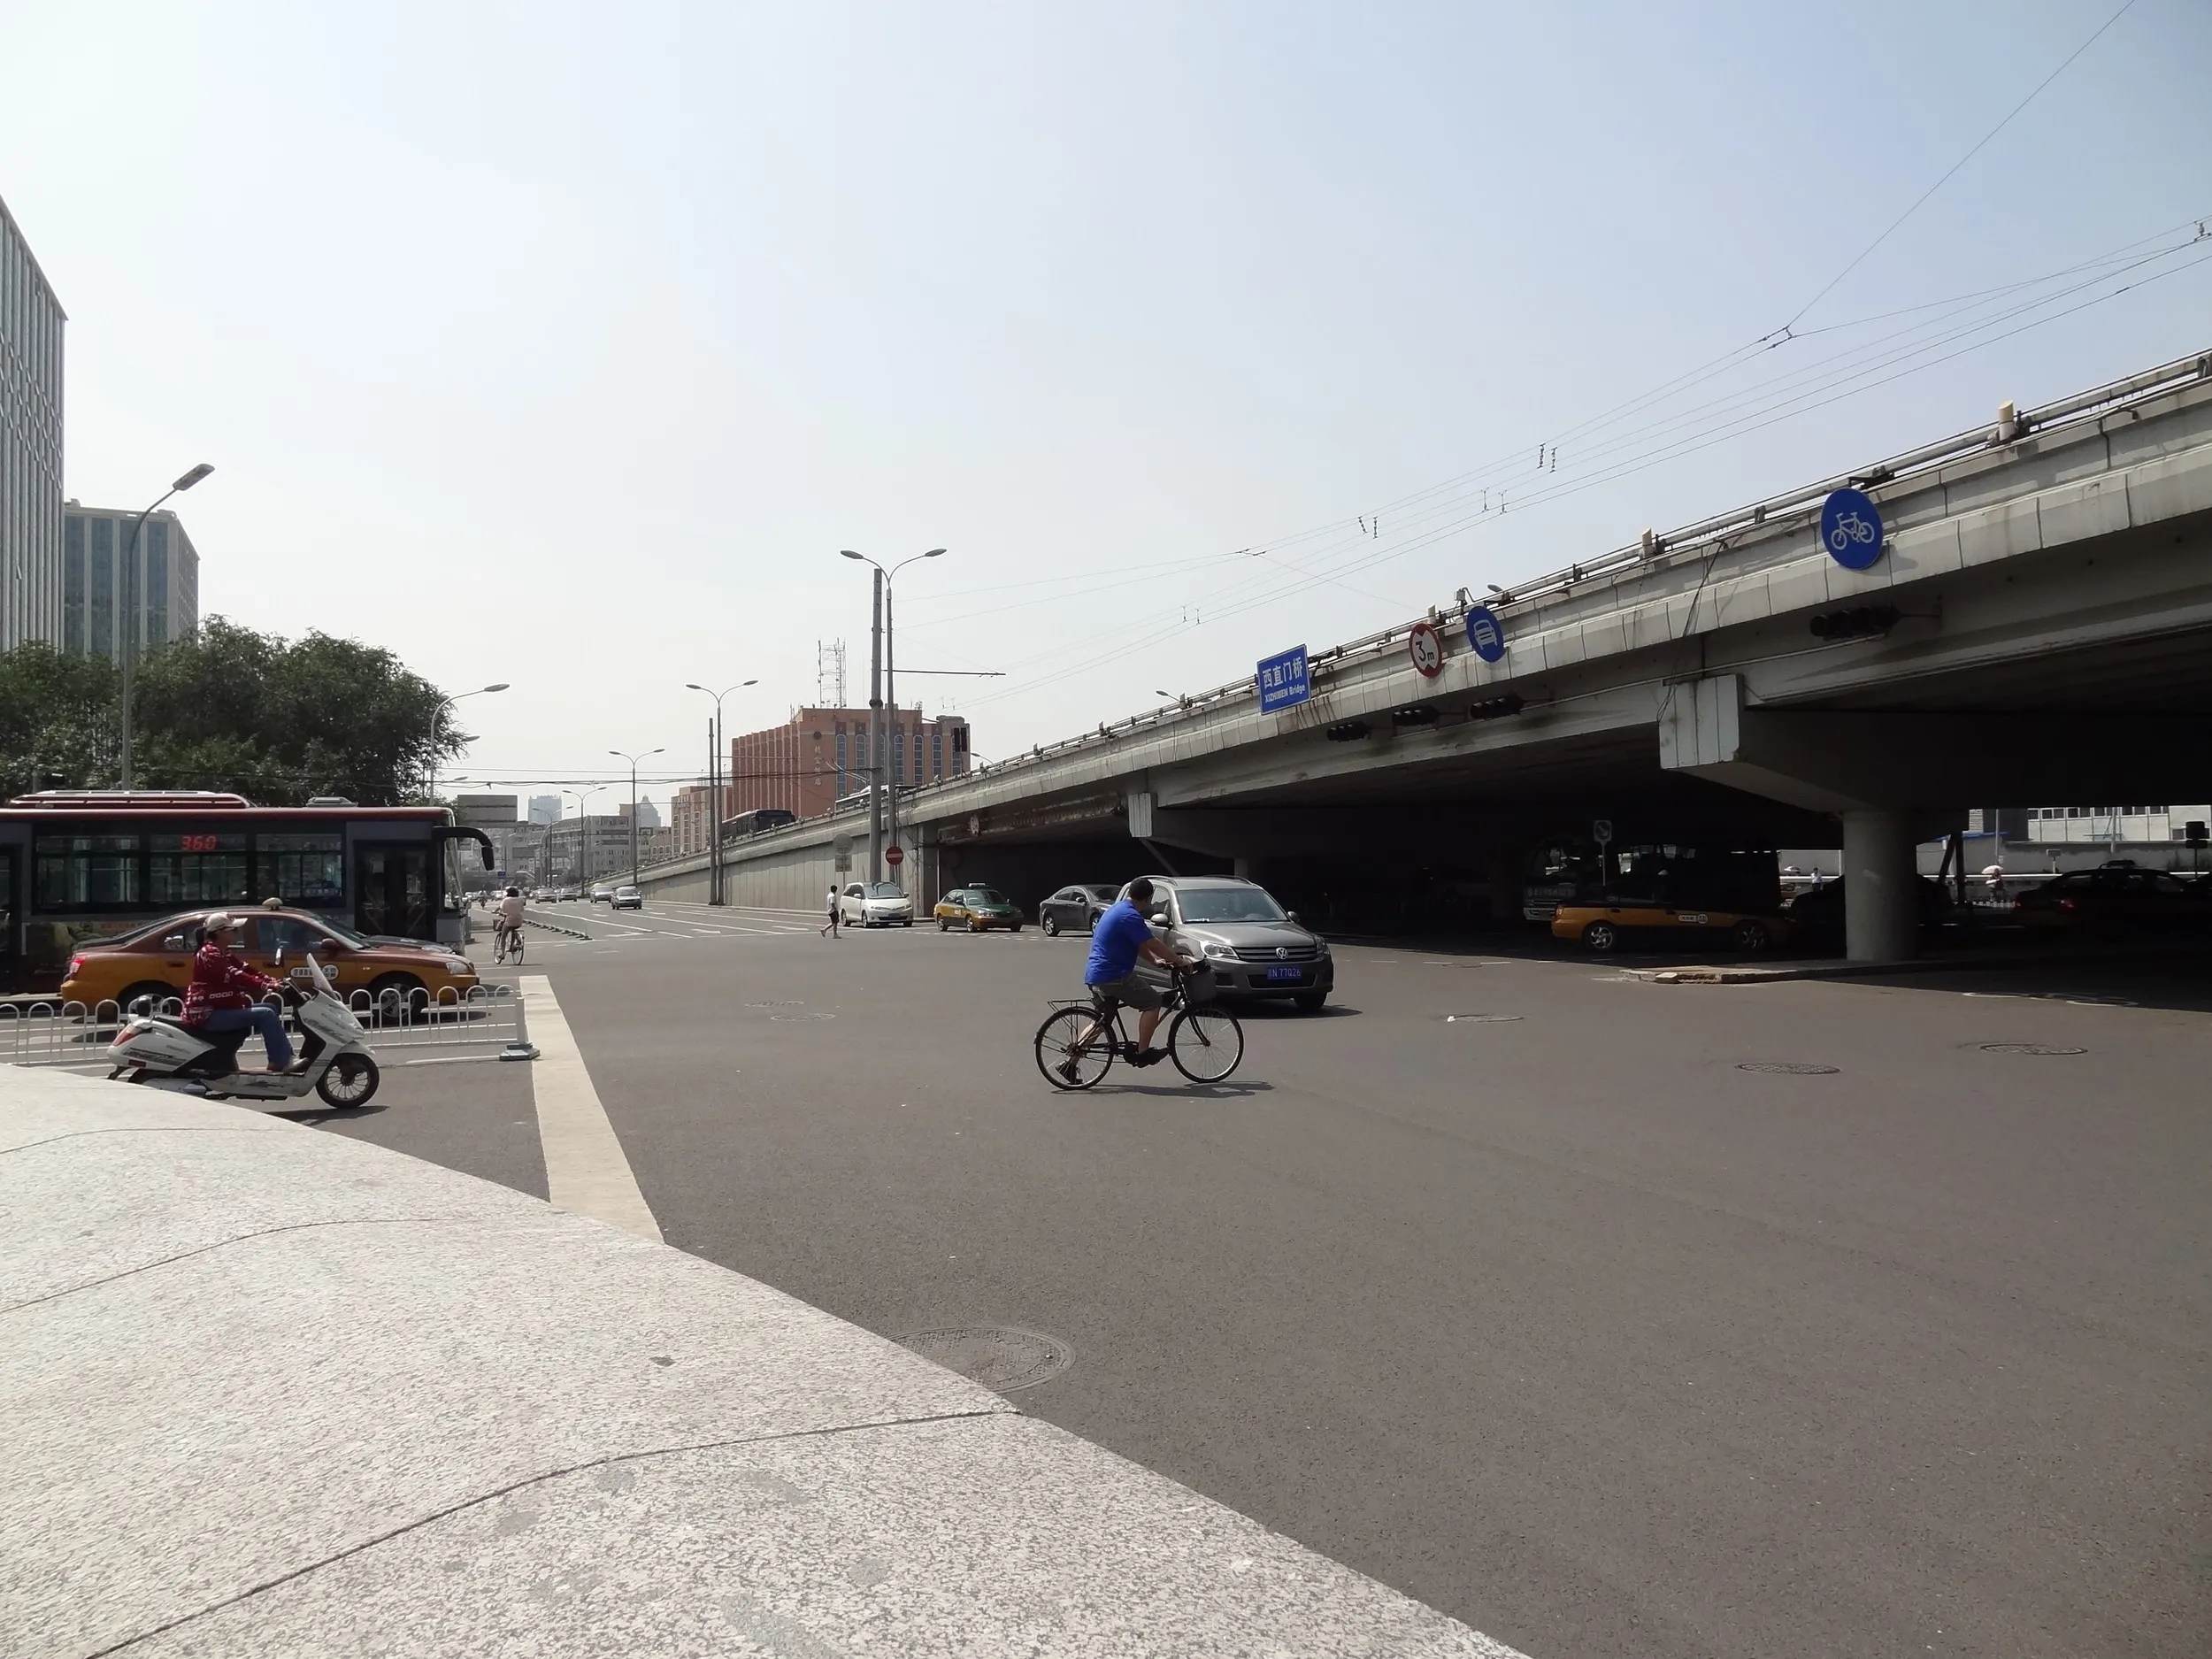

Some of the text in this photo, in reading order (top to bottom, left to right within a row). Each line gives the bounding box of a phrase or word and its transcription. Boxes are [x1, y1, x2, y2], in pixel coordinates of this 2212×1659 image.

[1416, 641, 1435, 662] 3m
[1263, 657, 1302, 689] 西直门桥
[1264, 683, 1305, 703] XIZHIMEN Bridge
[182, 835, 217, 850] 360
